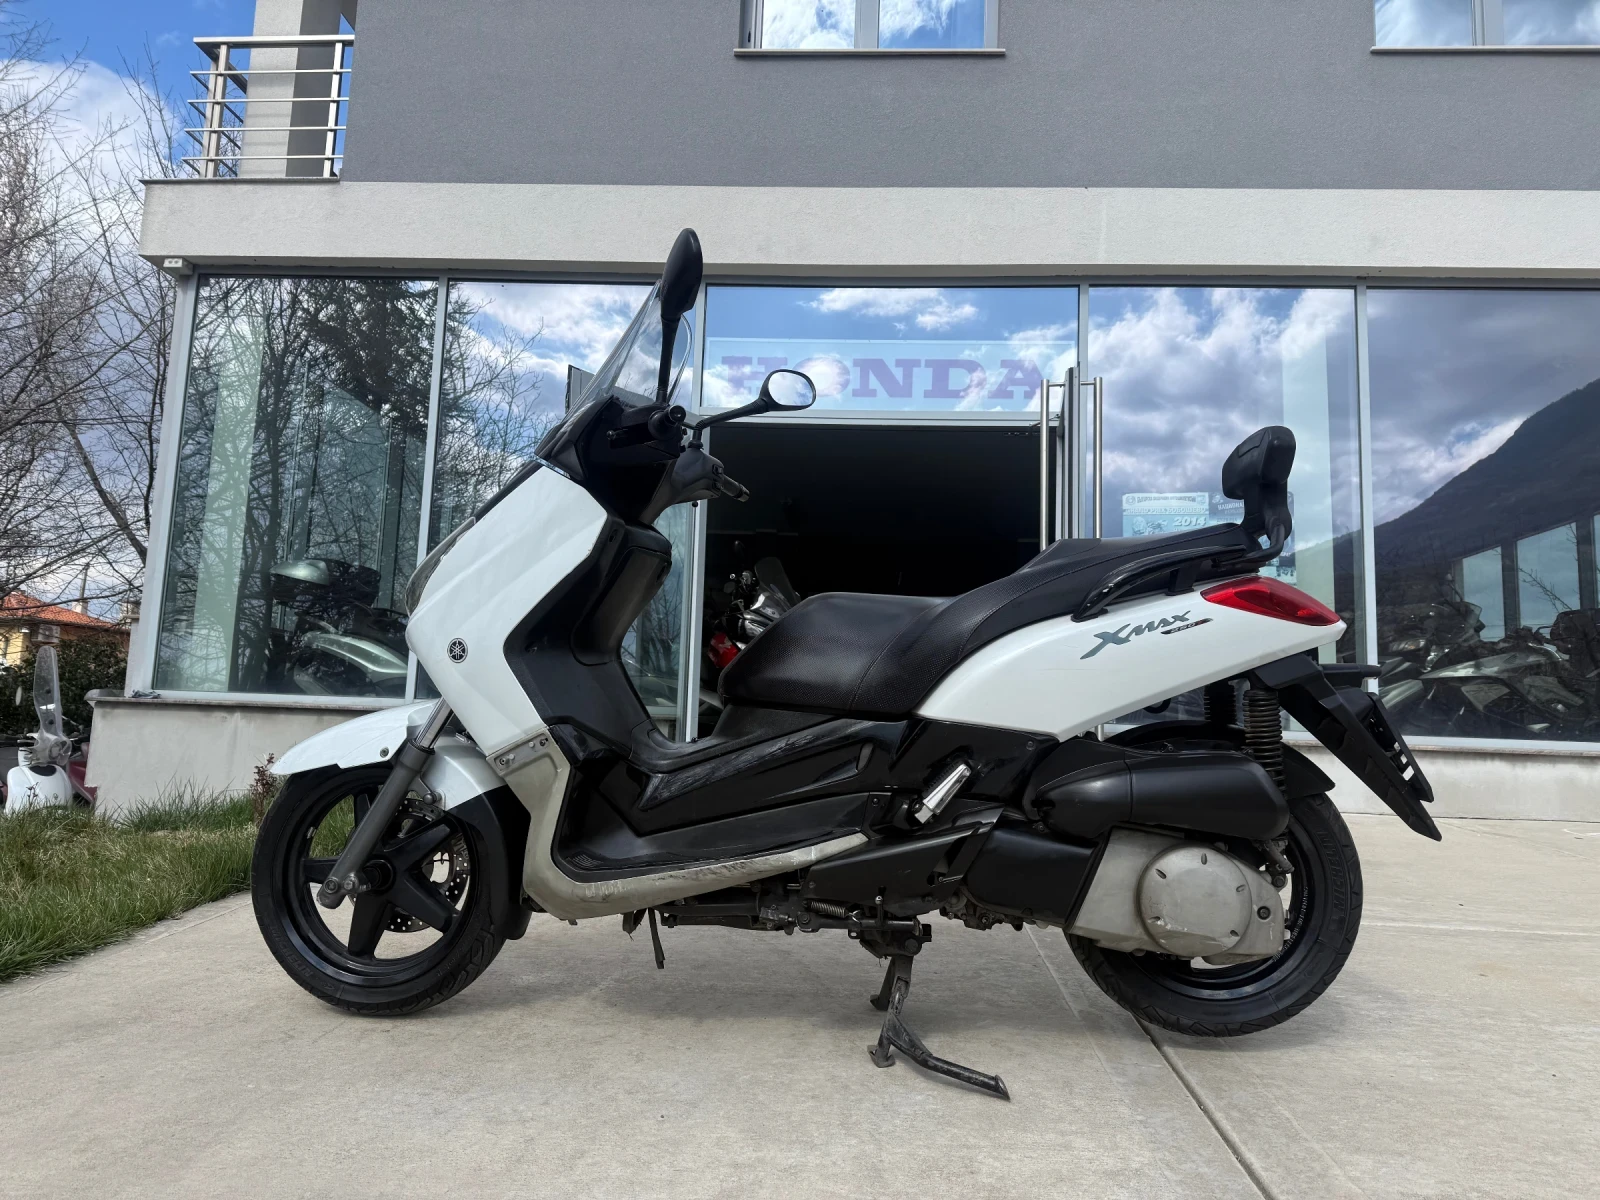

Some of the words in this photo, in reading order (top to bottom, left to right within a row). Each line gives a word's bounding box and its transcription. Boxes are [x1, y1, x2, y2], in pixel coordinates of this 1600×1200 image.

[721, 355, 1044, 400] HONDA
[1173, 516, 1207, 527] 2014
[271, 925, 315, 978] MICHELIN
